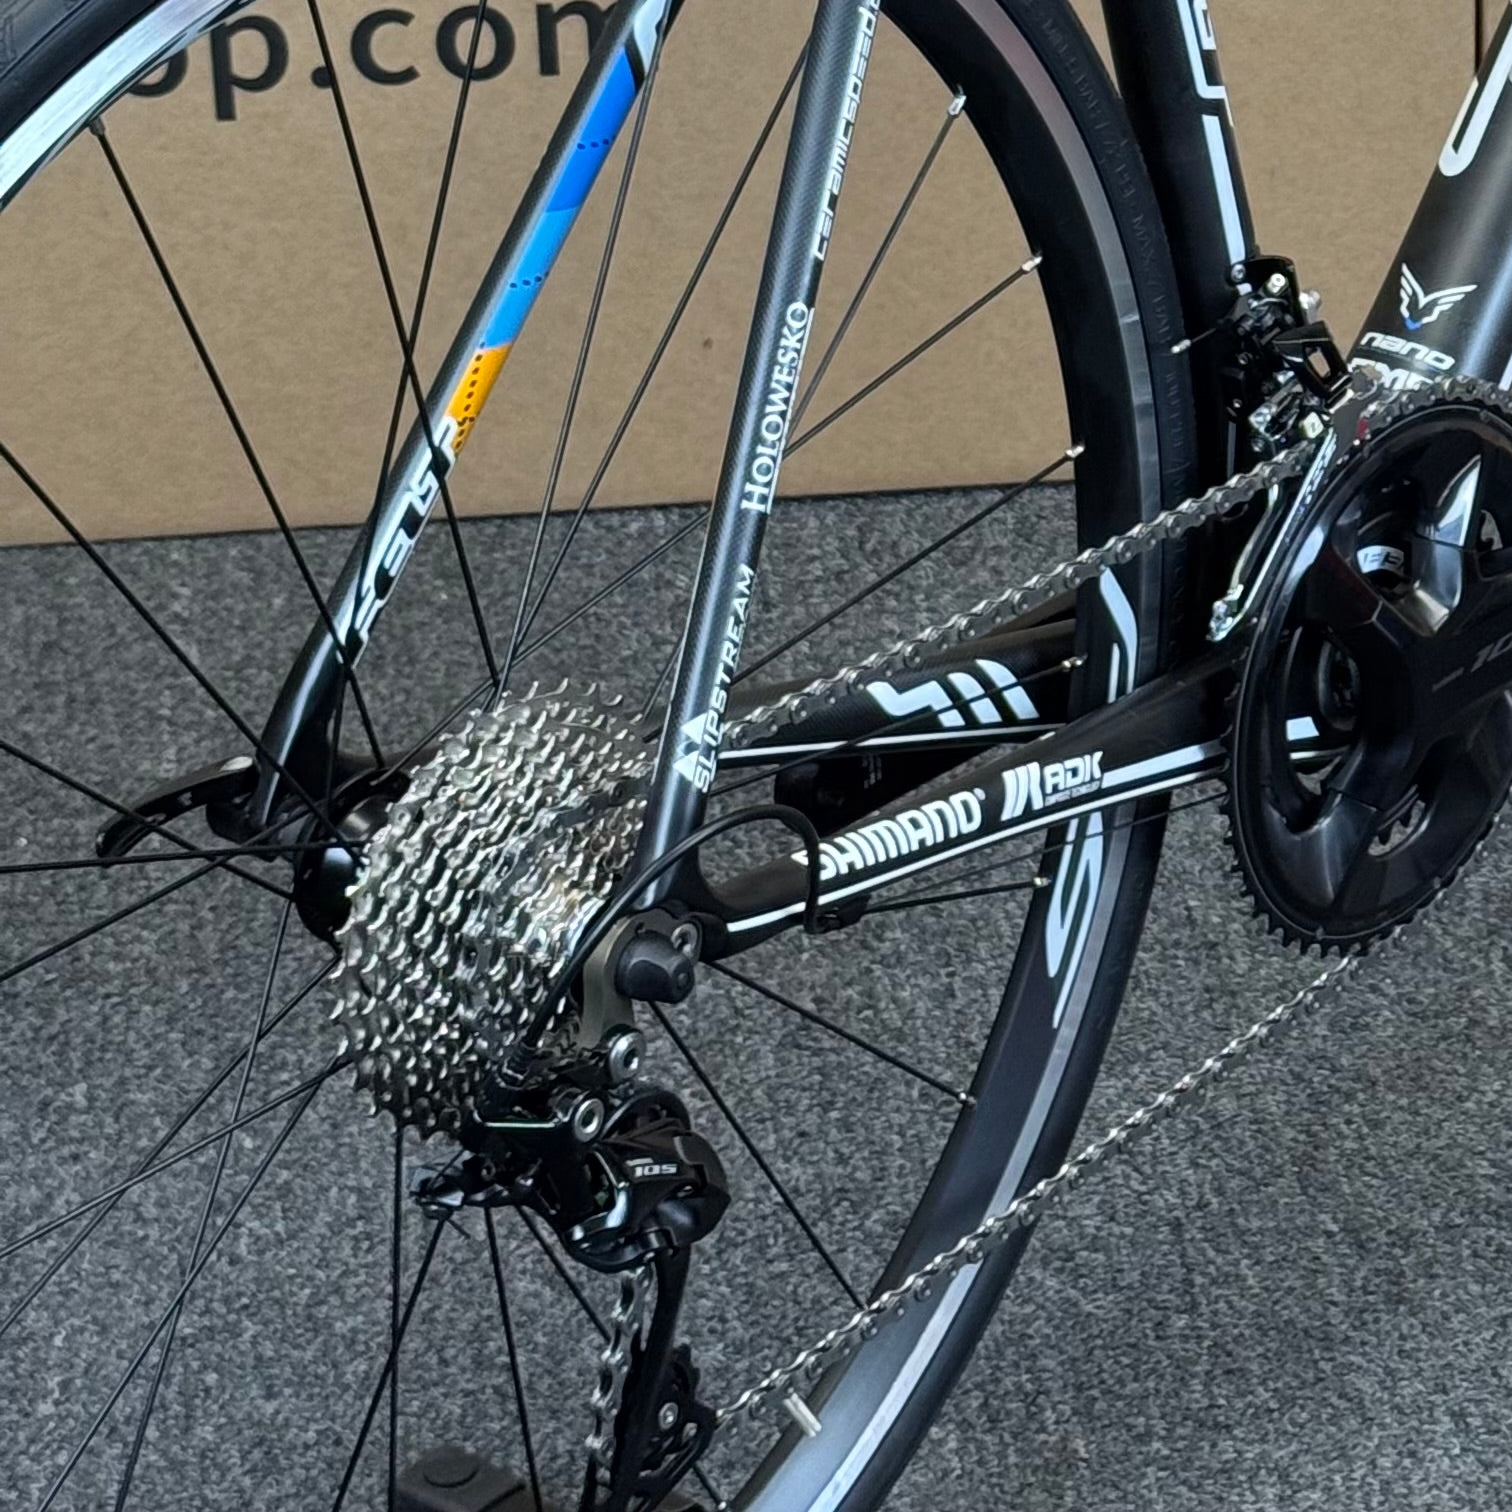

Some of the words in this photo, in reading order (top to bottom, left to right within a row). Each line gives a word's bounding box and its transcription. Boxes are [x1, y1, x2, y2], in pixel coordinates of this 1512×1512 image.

[741, 299, 810, 514] HOLOWESKO
[1361, 329, 1455, 373] nano
[336, 415, 458, 665] FELT
[693, 562, 756, 795] SLIPSTREAM
[792, 789, 982, 881] SHIMANO
[633, 1163, 678, 1179] 105
